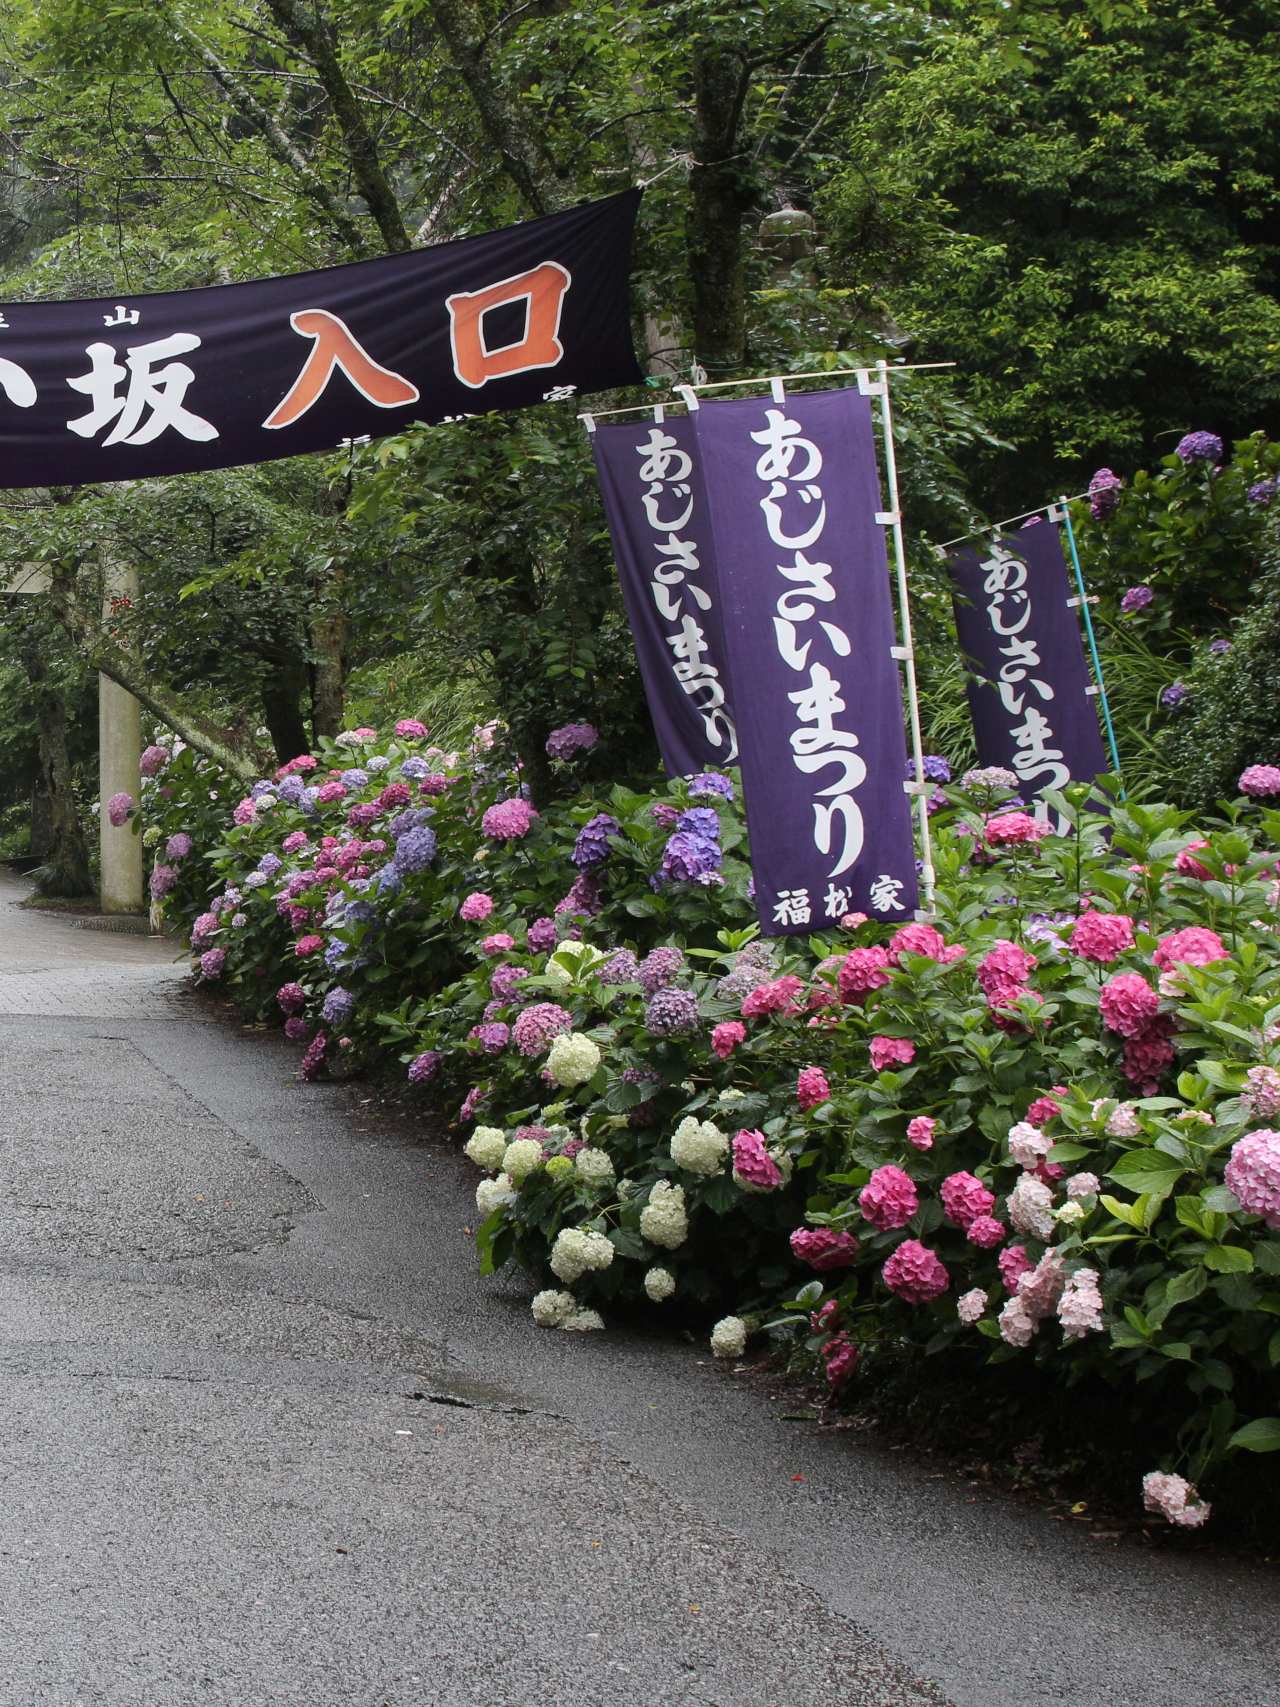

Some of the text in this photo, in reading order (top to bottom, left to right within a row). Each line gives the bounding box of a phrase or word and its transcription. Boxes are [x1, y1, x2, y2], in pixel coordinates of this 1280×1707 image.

[634, 429, 739, 764] あじさいまつり
[750, 409, 867, 878] あじさいまつり
[772, 874, 907, 926] 福松家
